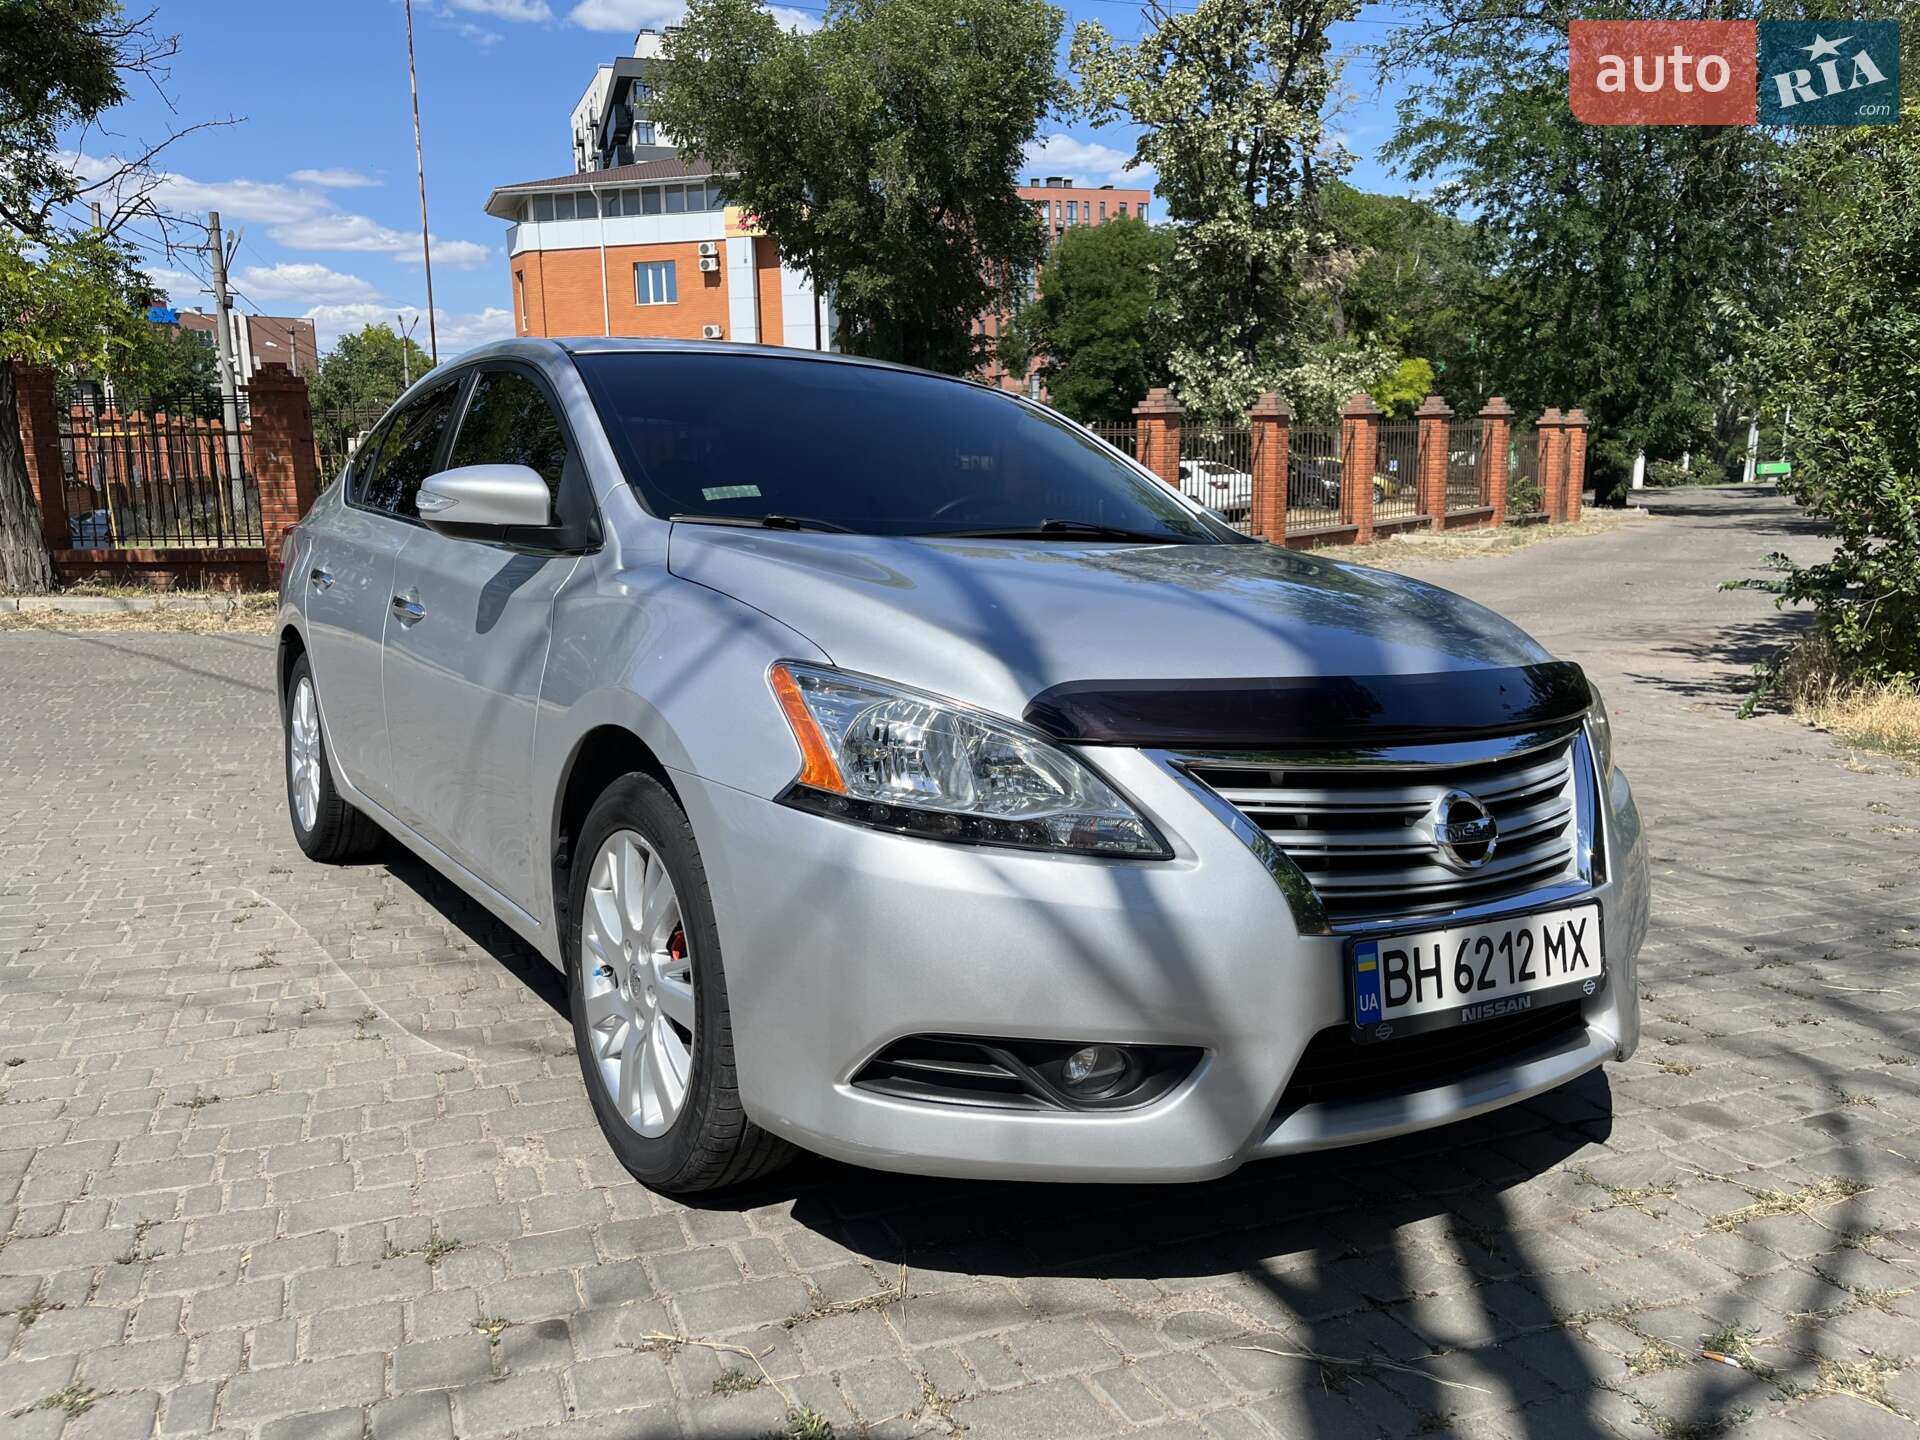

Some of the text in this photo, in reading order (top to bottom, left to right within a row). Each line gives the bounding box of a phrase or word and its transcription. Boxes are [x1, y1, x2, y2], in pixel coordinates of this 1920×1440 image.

[1382, 917, 1590, 1008] BH 6212 MX
[1359, 992, 1379, 1012] UA
[1461, 995, 1531, 1022] NISSAN
